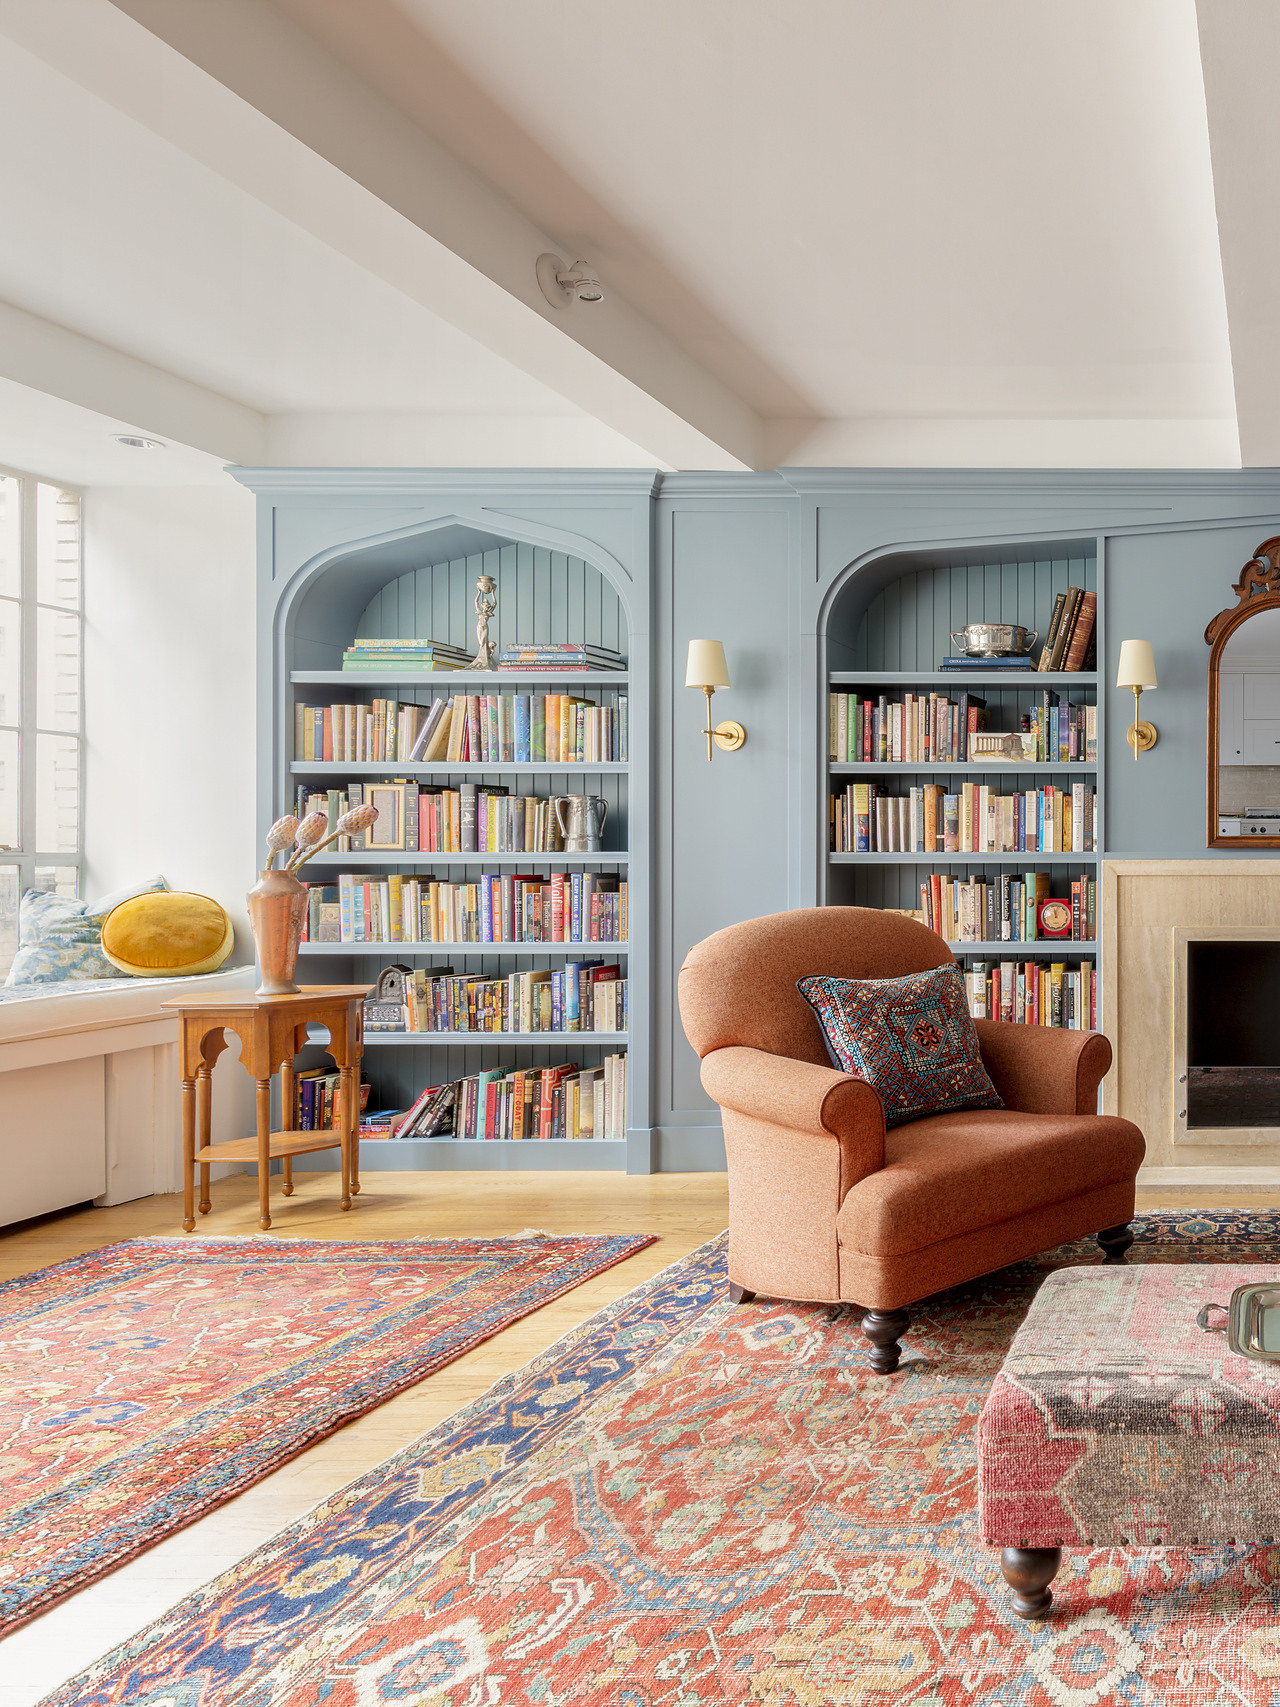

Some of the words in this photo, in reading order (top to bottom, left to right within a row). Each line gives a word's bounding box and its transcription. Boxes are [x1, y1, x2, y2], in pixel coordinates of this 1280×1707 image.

[552, 877, 562, 904] Wolf
[554, 912, 562, 932] Hall
[1052, 977, 1061, 1014] Mayflower
